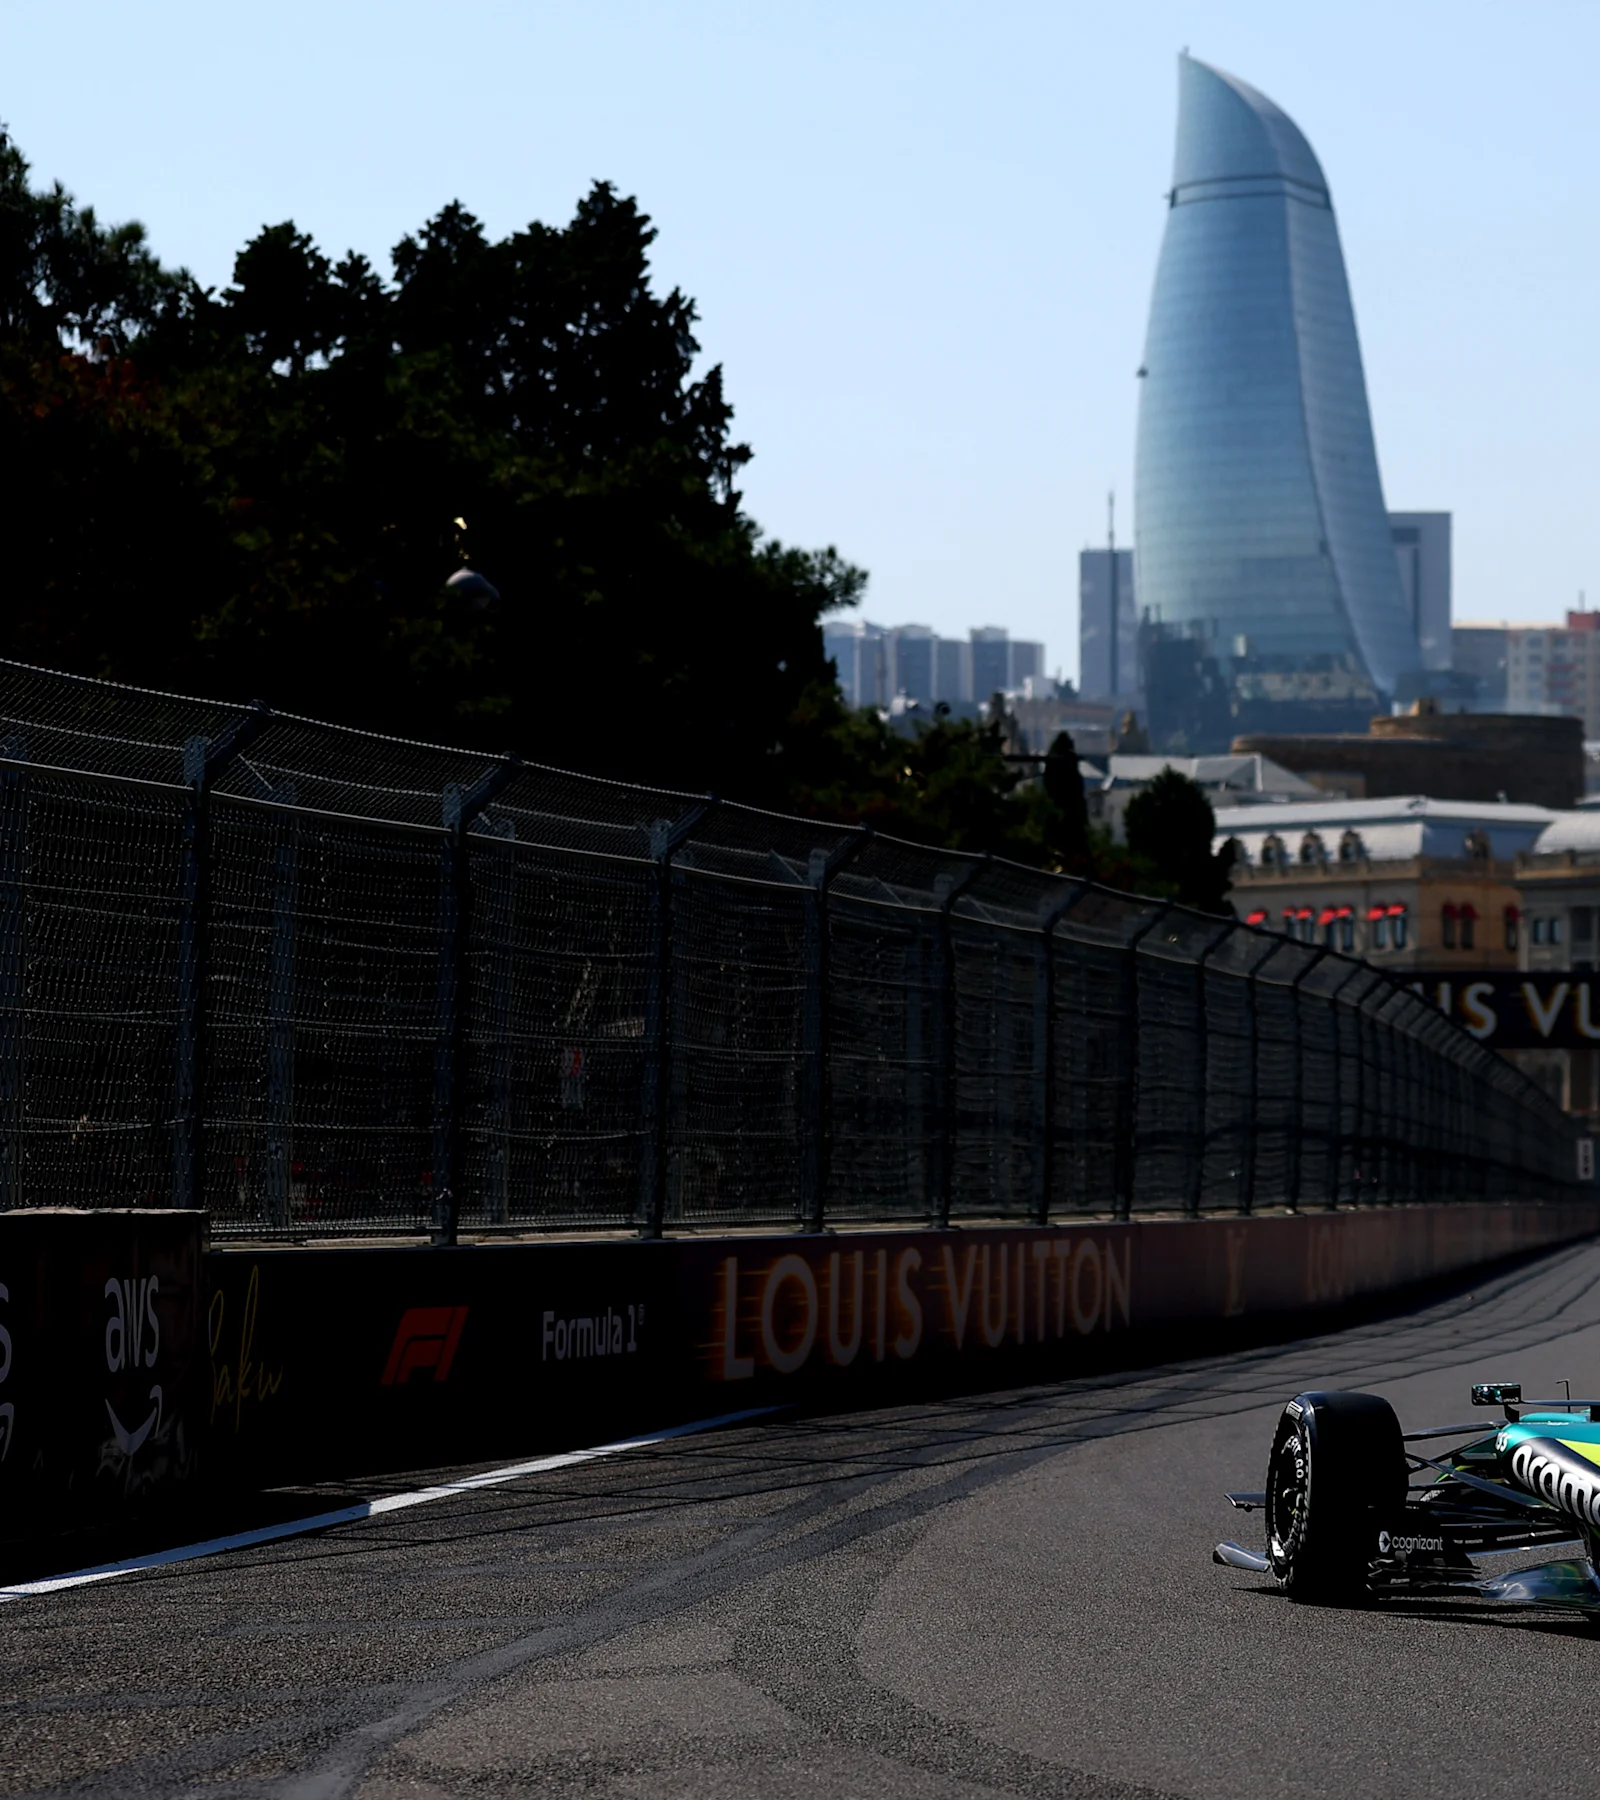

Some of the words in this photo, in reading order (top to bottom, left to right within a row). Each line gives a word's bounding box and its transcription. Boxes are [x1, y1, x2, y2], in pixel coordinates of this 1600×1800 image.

[104, 1274, 160, 1373] aws
[541, 1306, 623, 1362] Formula
[718, 1248, 924, 1381] LOUIS
[942, 1235, 1132, 1352] VUITTON
[1391, 1533, 1444, 1555] cognizant
